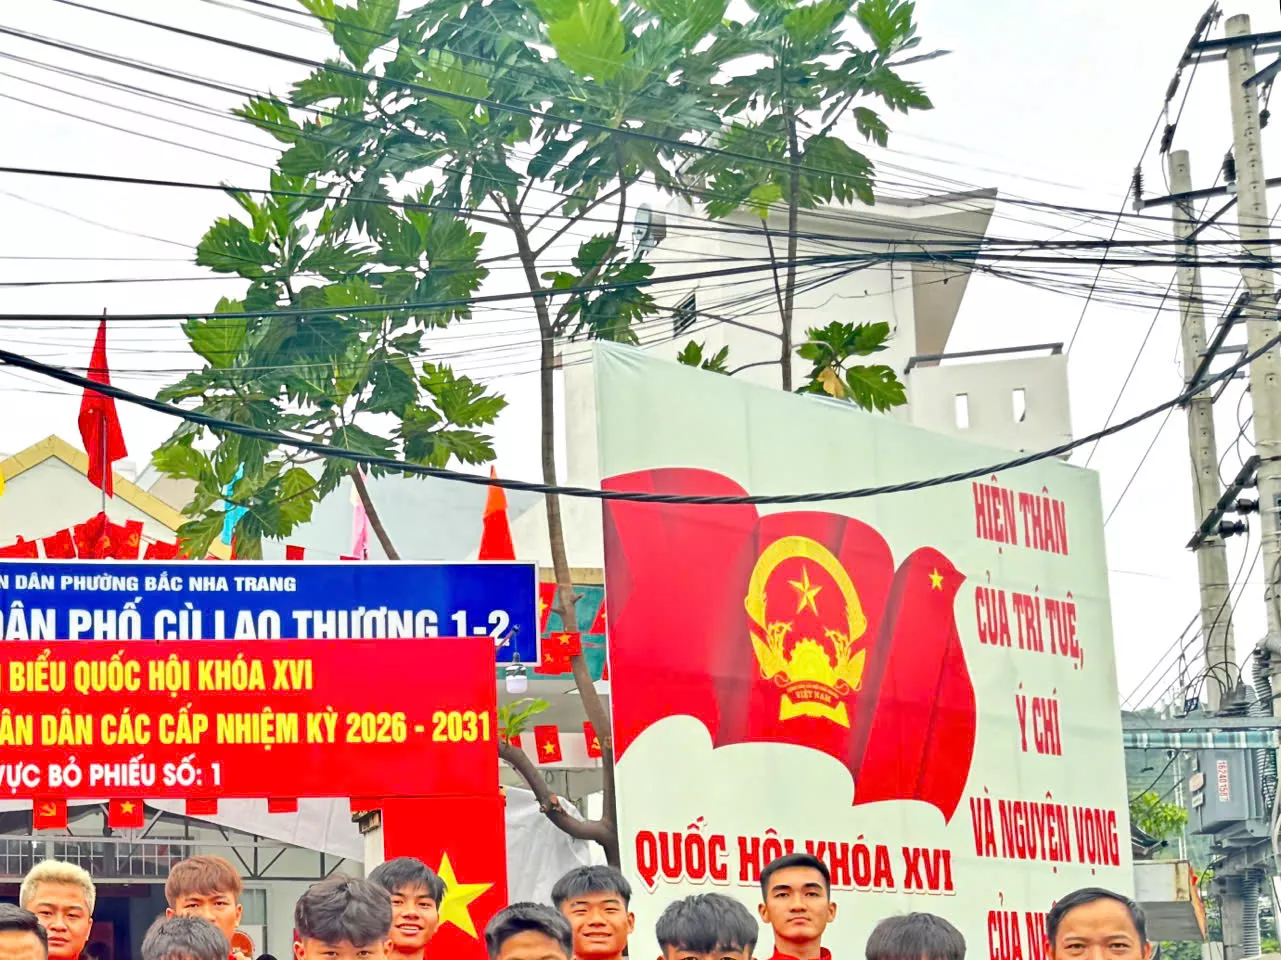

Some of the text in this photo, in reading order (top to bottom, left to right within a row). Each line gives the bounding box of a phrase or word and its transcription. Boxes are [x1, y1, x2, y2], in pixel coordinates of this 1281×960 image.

[972, 475, 1068, 556] HIỆN THÂN
[16, 572, 54, 589] DÂN
[61, 573, 138, 591] PHƯỜNG
[145, 571, 182, 591] BẮC
[189, 577, 228, 591] NHA
[234, 577, 296, 591] TRANG
[69, 597, 142, 641] PHỐ
[155, 602, 204, 640] CÙ
[210, 610, 280, 640] LAO
[452, 610, 512, 646] 1-2
[975, 571, 1084, 668] CỦA TRÍ TUỆ,
[10, 649, 66, 692] BIỂU
[74, 650, 140, 694] QUỐC
[149, 654, 189, 697] HỘI
[198, 654, 265, 690] KHÓA
[273, 660, 312, 689] XVI
[42, 708, 92, 745] DÂN
[101, 708, 150, 745] CÁC
[159, 703, 208, 744] CẤP
[217, 707, 298, 750] NHIỆM
[307, 706, 338, 743] KỲ
[346, 712, 406, 743] 2026
[432, 711, 489, 742] 2031
[1015, 684, 1062, 756] Ý CHÍ
[49, 756, 82, 787] BỎ
[90, 754, 155, 786] PHIẾU
[163, 754, 202, 786] SỐ:
[212, 763, 220, 785] 1
[635, 816, 728, 888] QUỐC
[902, 846, 954, 891] XVI
[969, 787, 1120, 874] VÀ NGUYỆN VỌNG
